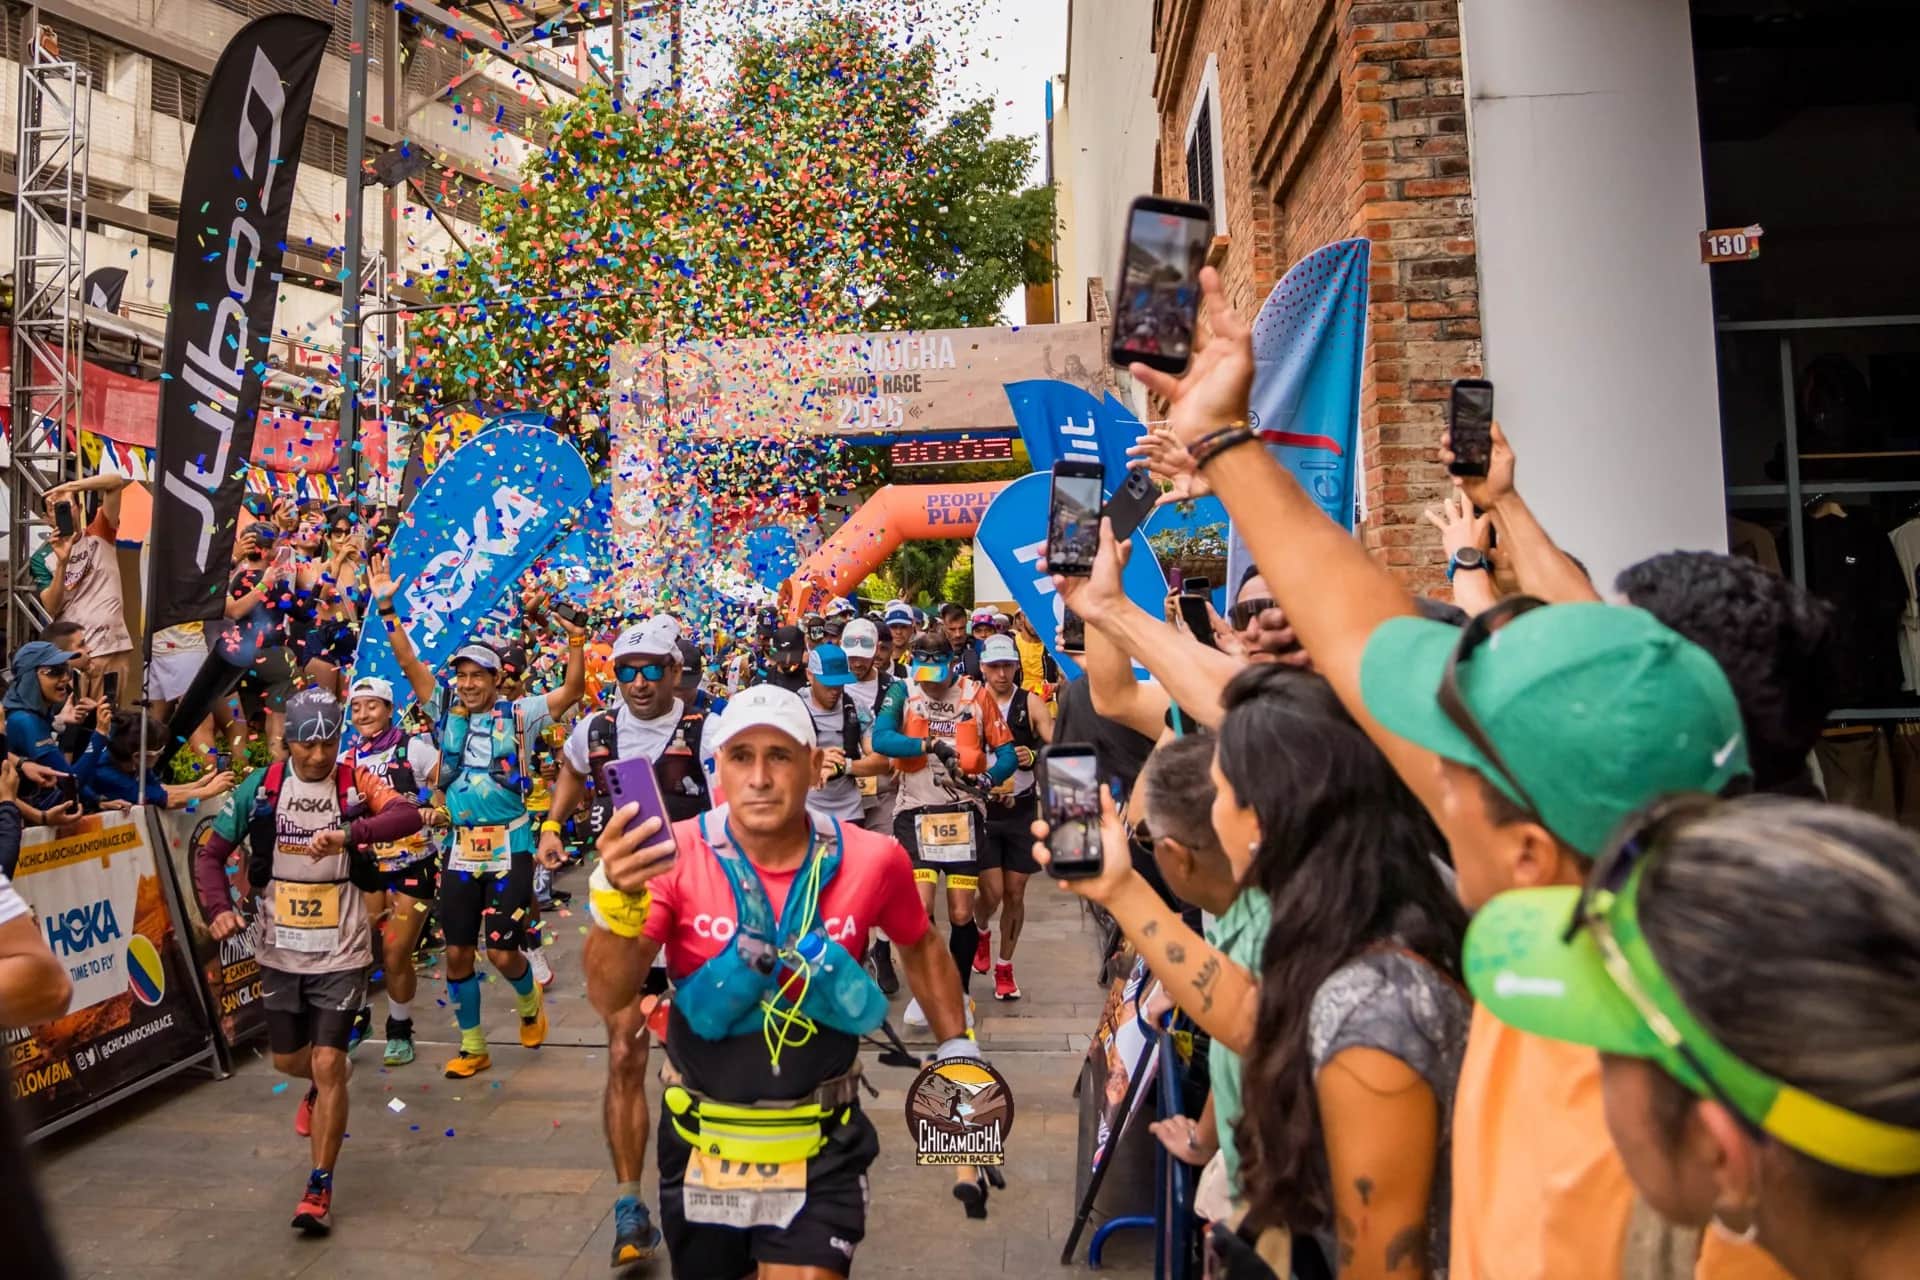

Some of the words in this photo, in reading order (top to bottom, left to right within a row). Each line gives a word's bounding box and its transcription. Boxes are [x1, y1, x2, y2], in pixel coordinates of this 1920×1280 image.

[1708, 234, 1747, 256] 130
[882, 373, 922, 394] RACE
[837, 395, 904, 430] 2026
[929, 702, 955, 714] OKA
[287, 797, 333, 813] HOKA
[932, 824, 958, 838] 165
[289, 898, 323, 917] 132
[46, 899, 121, 957] HOKA
[70, 964, 89, 982] TIME
[90, 959, 100, 976] TO
[102, 953, 114, 971] FLY
[101, 1014, 174, 1058] @CHICAMOCHARACE
[15, 1060, 73, 1099] OLOMBIA
